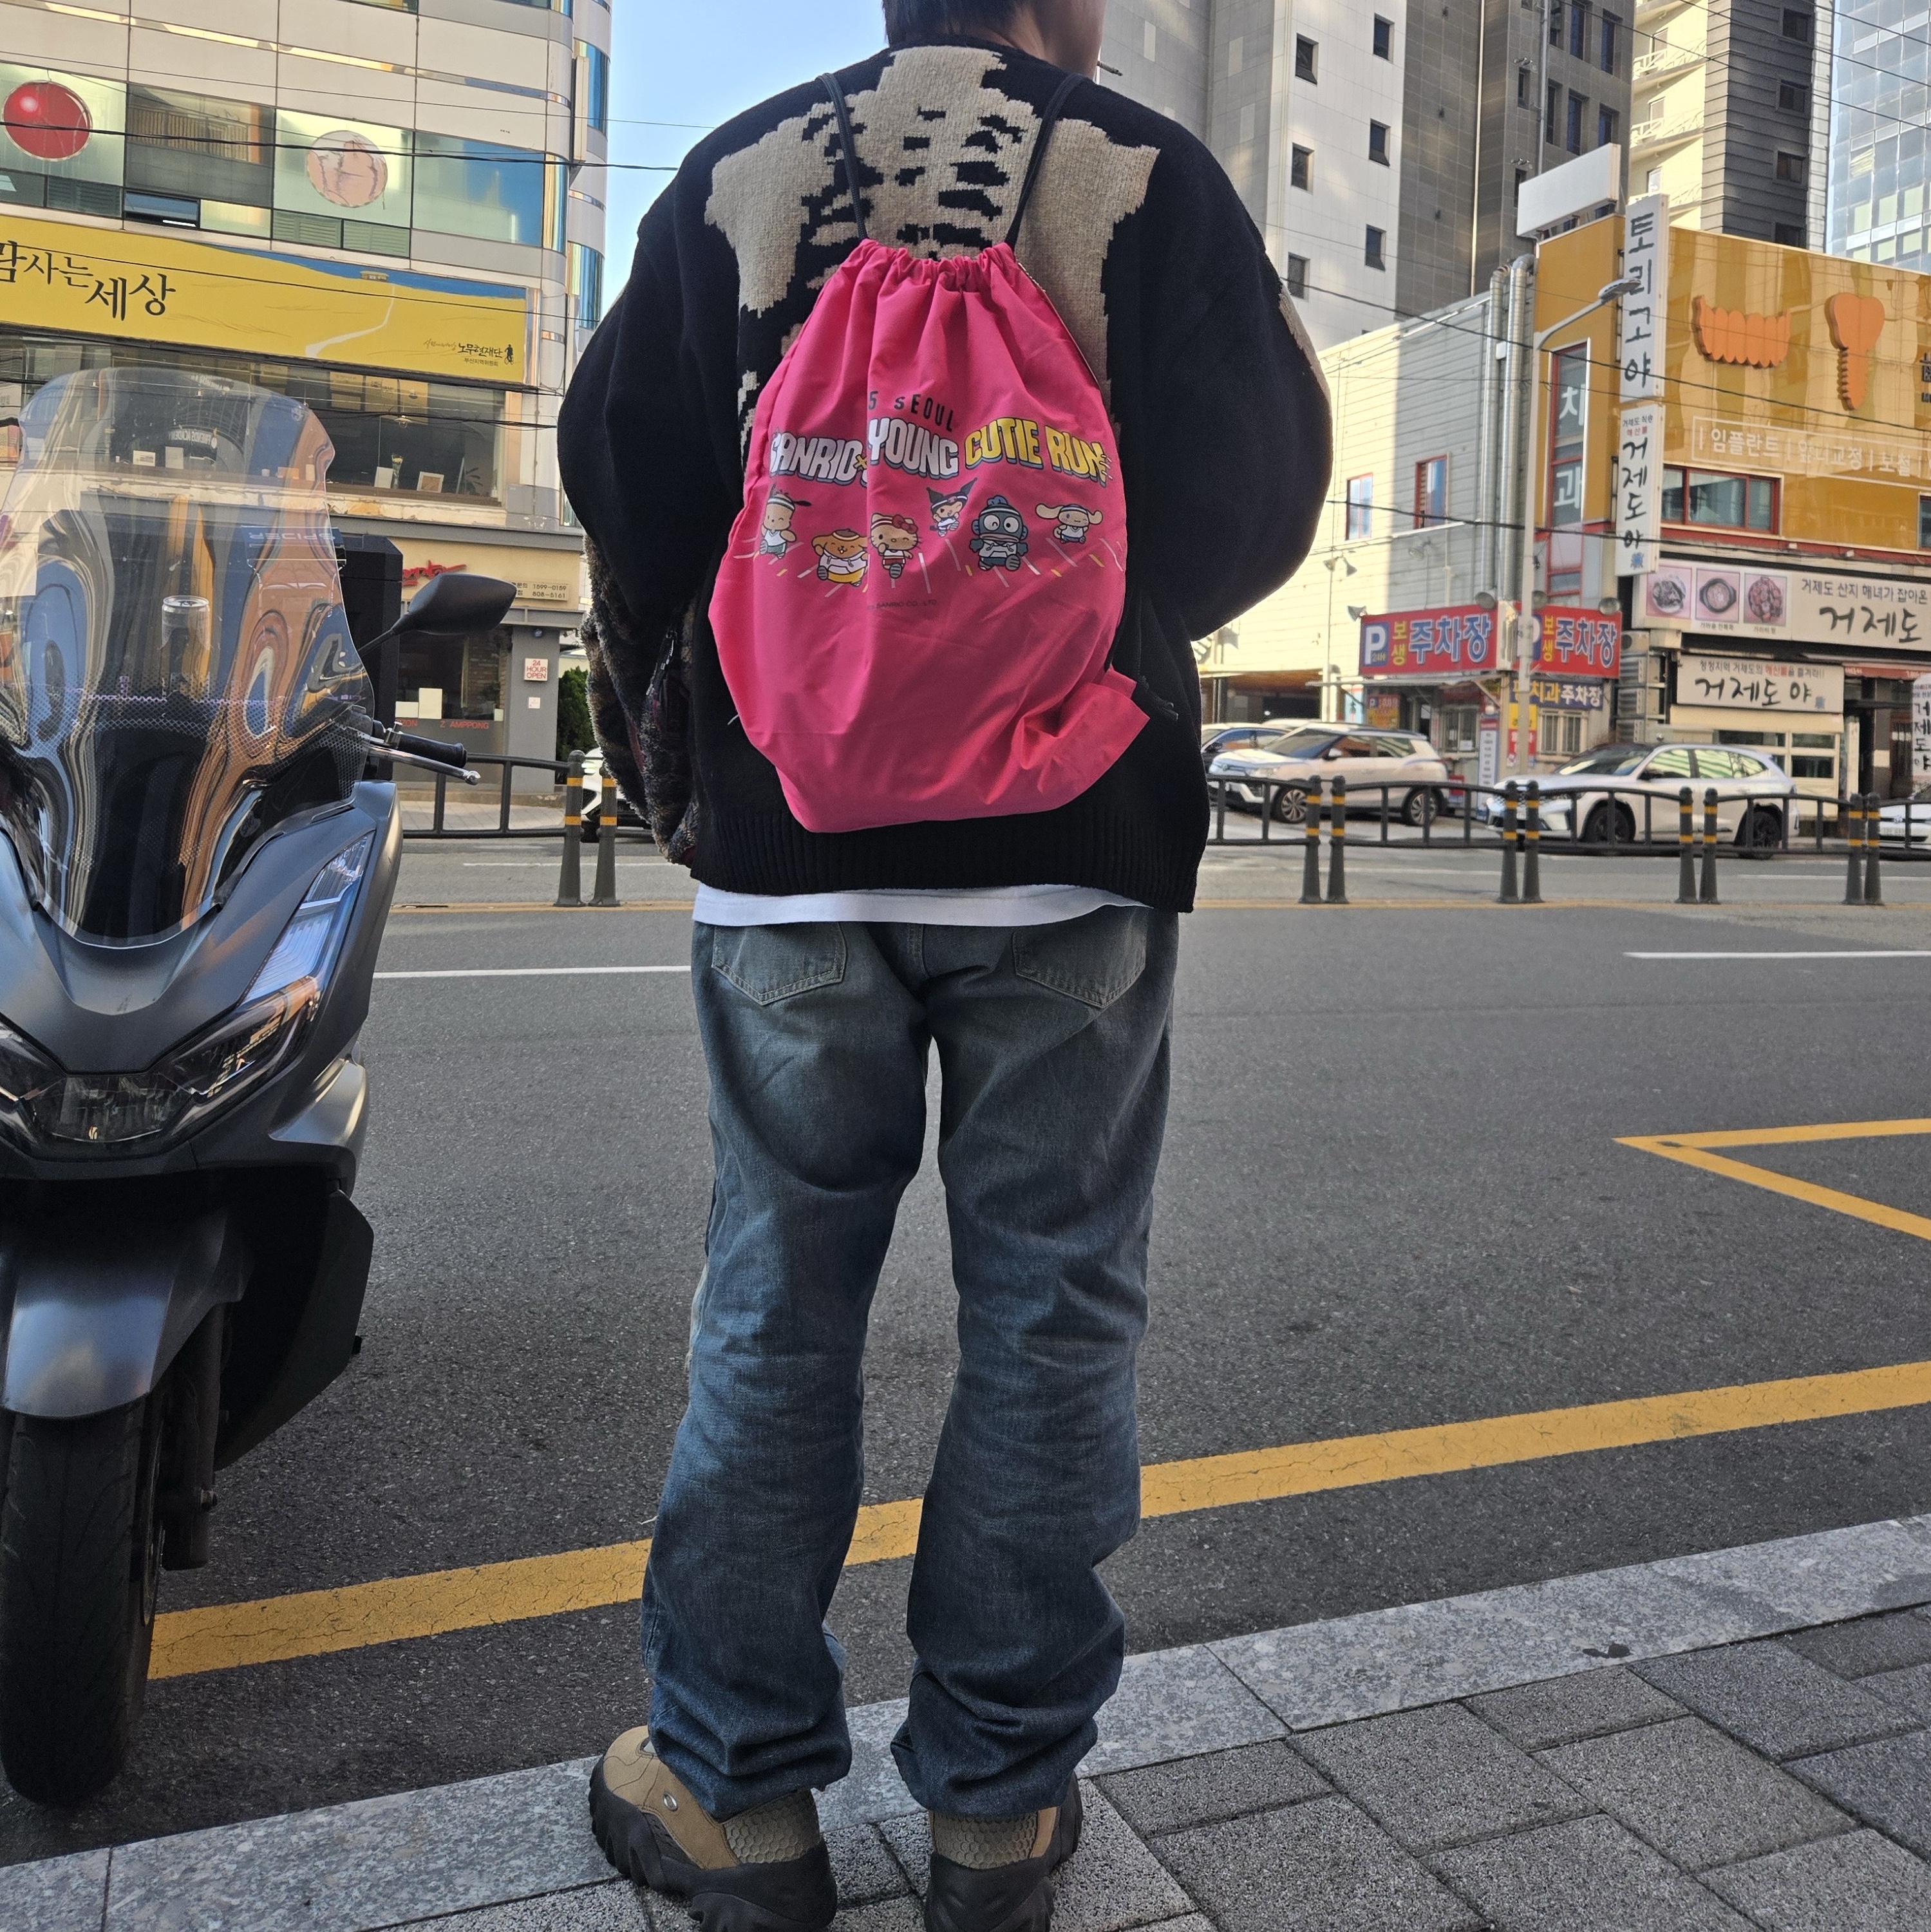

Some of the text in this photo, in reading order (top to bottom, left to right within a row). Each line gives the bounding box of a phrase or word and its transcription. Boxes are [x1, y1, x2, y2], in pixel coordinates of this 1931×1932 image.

[84, 272, 176, 321] 세상
[1625, 212, 1655, 388] 토리고야
[457, 342, 504, 359] 노무현재단
[894, 393, 953, 432] SEOUL
[868, 417, 959, 479] YOUNG
[965, 417, 1106, 488] CUTIE RUN
[1711, 427, 1781, 457] 임플란트
[1802, 579, 1928, 605] 거제도 산지 해녀가 잡아온
[1408, 615, 1493, 663] 주차장
[1554, 617, 1618, 670] 주차장
[1819, 605, 1922, 643] 거제도
[1700, 660, 1731, 673] 청정지역
[1733, 662, 1763, 675] 거제도의
